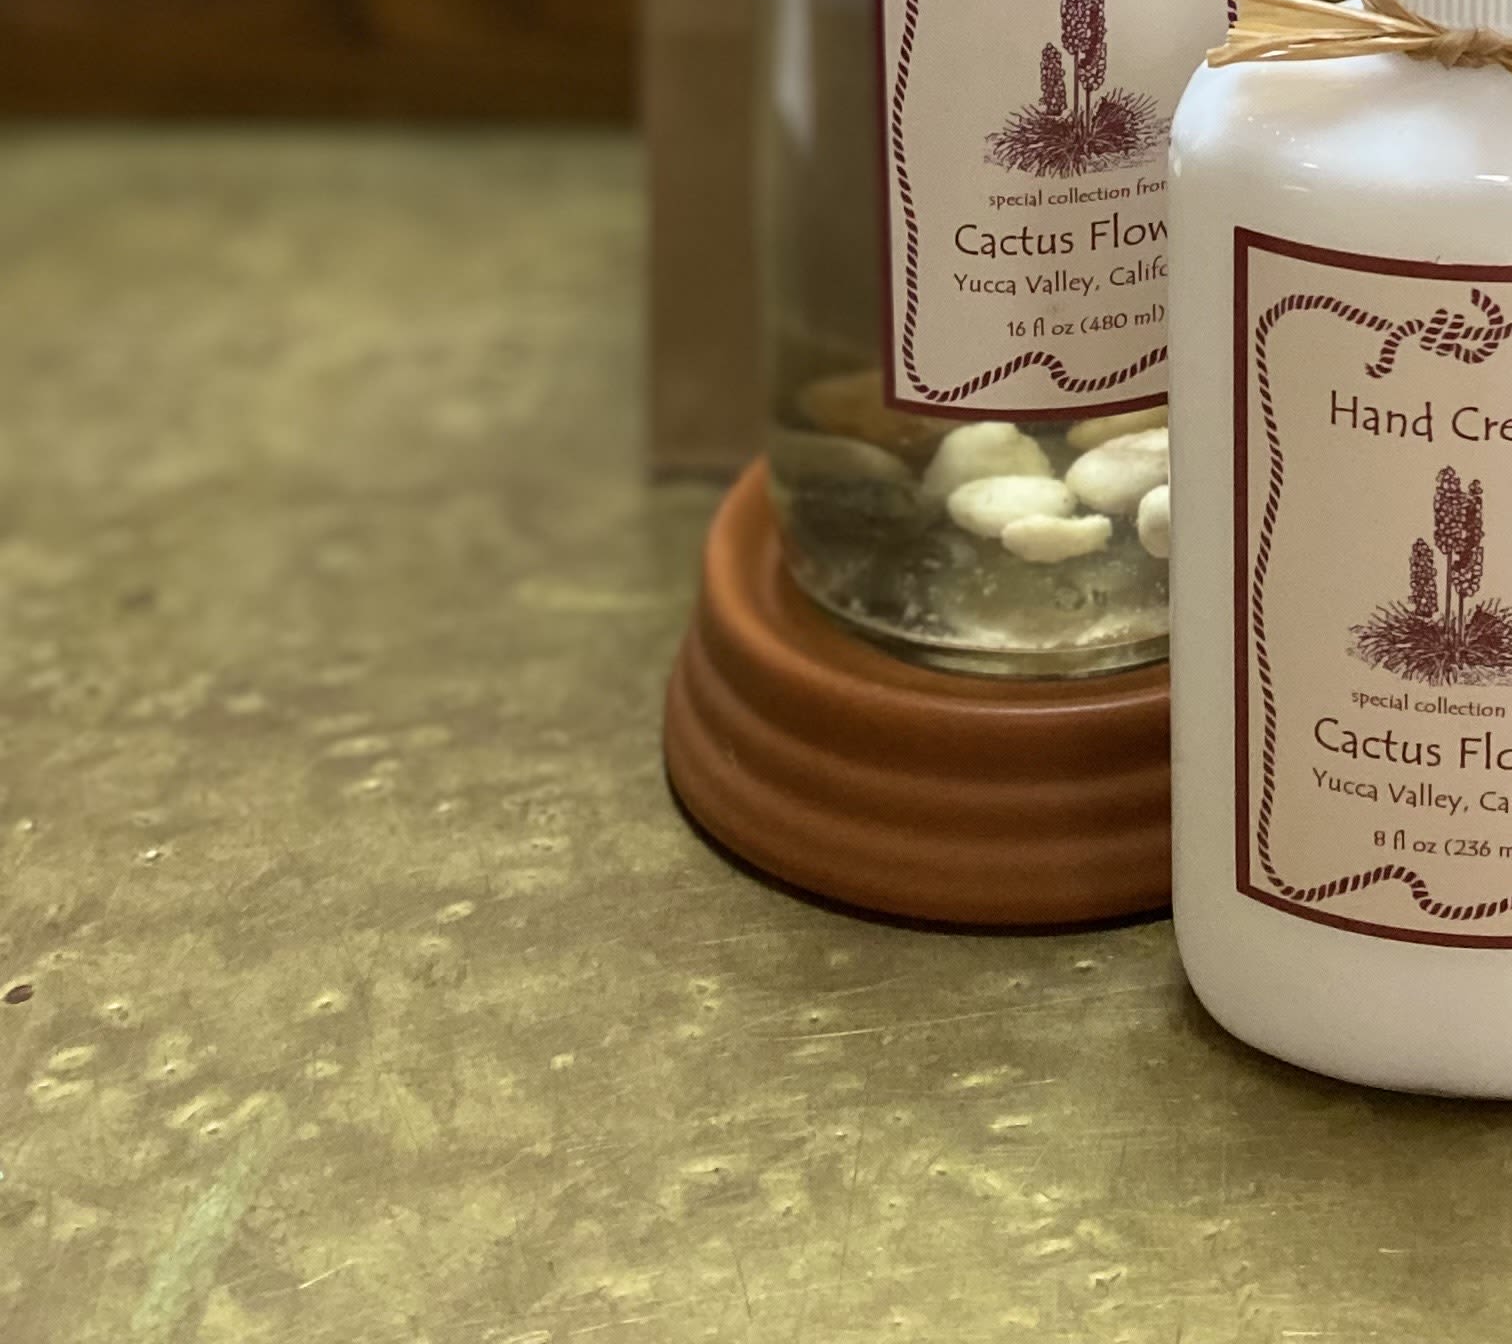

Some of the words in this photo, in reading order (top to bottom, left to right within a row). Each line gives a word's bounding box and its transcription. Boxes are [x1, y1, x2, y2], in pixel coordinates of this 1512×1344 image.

[988, 189, 1042, 210] special
[1047, 187, 1131, 205] collection
[954, 223, 1074, 259] Cactus
[1090, 212, 1168, 250] Flow
[954, 273, 1016, 296] Yucca
[1025, 269, 1100, 297] Valley,
[1007, 321, 1026, 337] 16
[1033, 317, 1044, 337] fl
[1051, 323, 1075, 336] oz
[1080, 313, 1128, 334] (480
[1134, 304, 1165, 326] ml)
[1331, 390, 1433, 442] Hand
[1352, 692, 1409, 711] special
[1414, 697, 1506, 718] collection
[1314, 718, 1441, 766] Cactus
[1312, 767, 1378, 802] Yucca
[1389, 783, 1469, 816] Valley,
[1373, 830, 1386, 847] 8
[1393, 829, 1405, 850] fl
[1413, 840, 1437, 854] oz
[1445, 838, 1491, 857] (236
